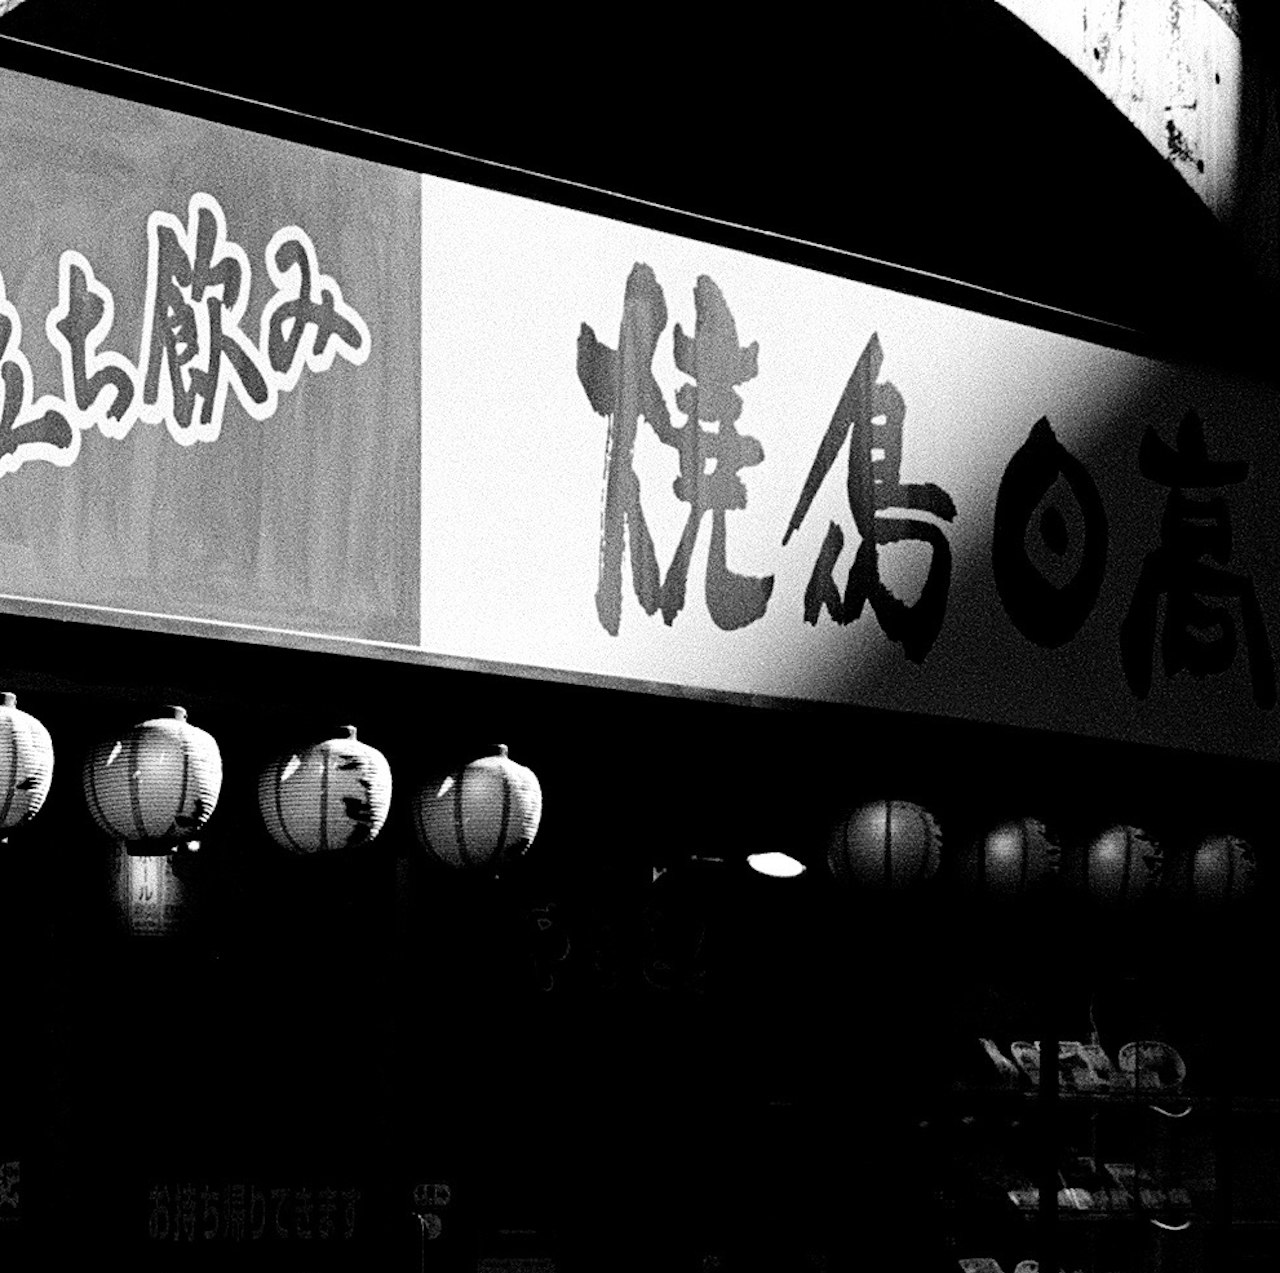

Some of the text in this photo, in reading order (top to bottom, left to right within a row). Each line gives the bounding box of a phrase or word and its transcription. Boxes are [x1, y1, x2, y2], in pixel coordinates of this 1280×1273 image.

[147, 1182, 363, 1243] お持ち帰りできます
